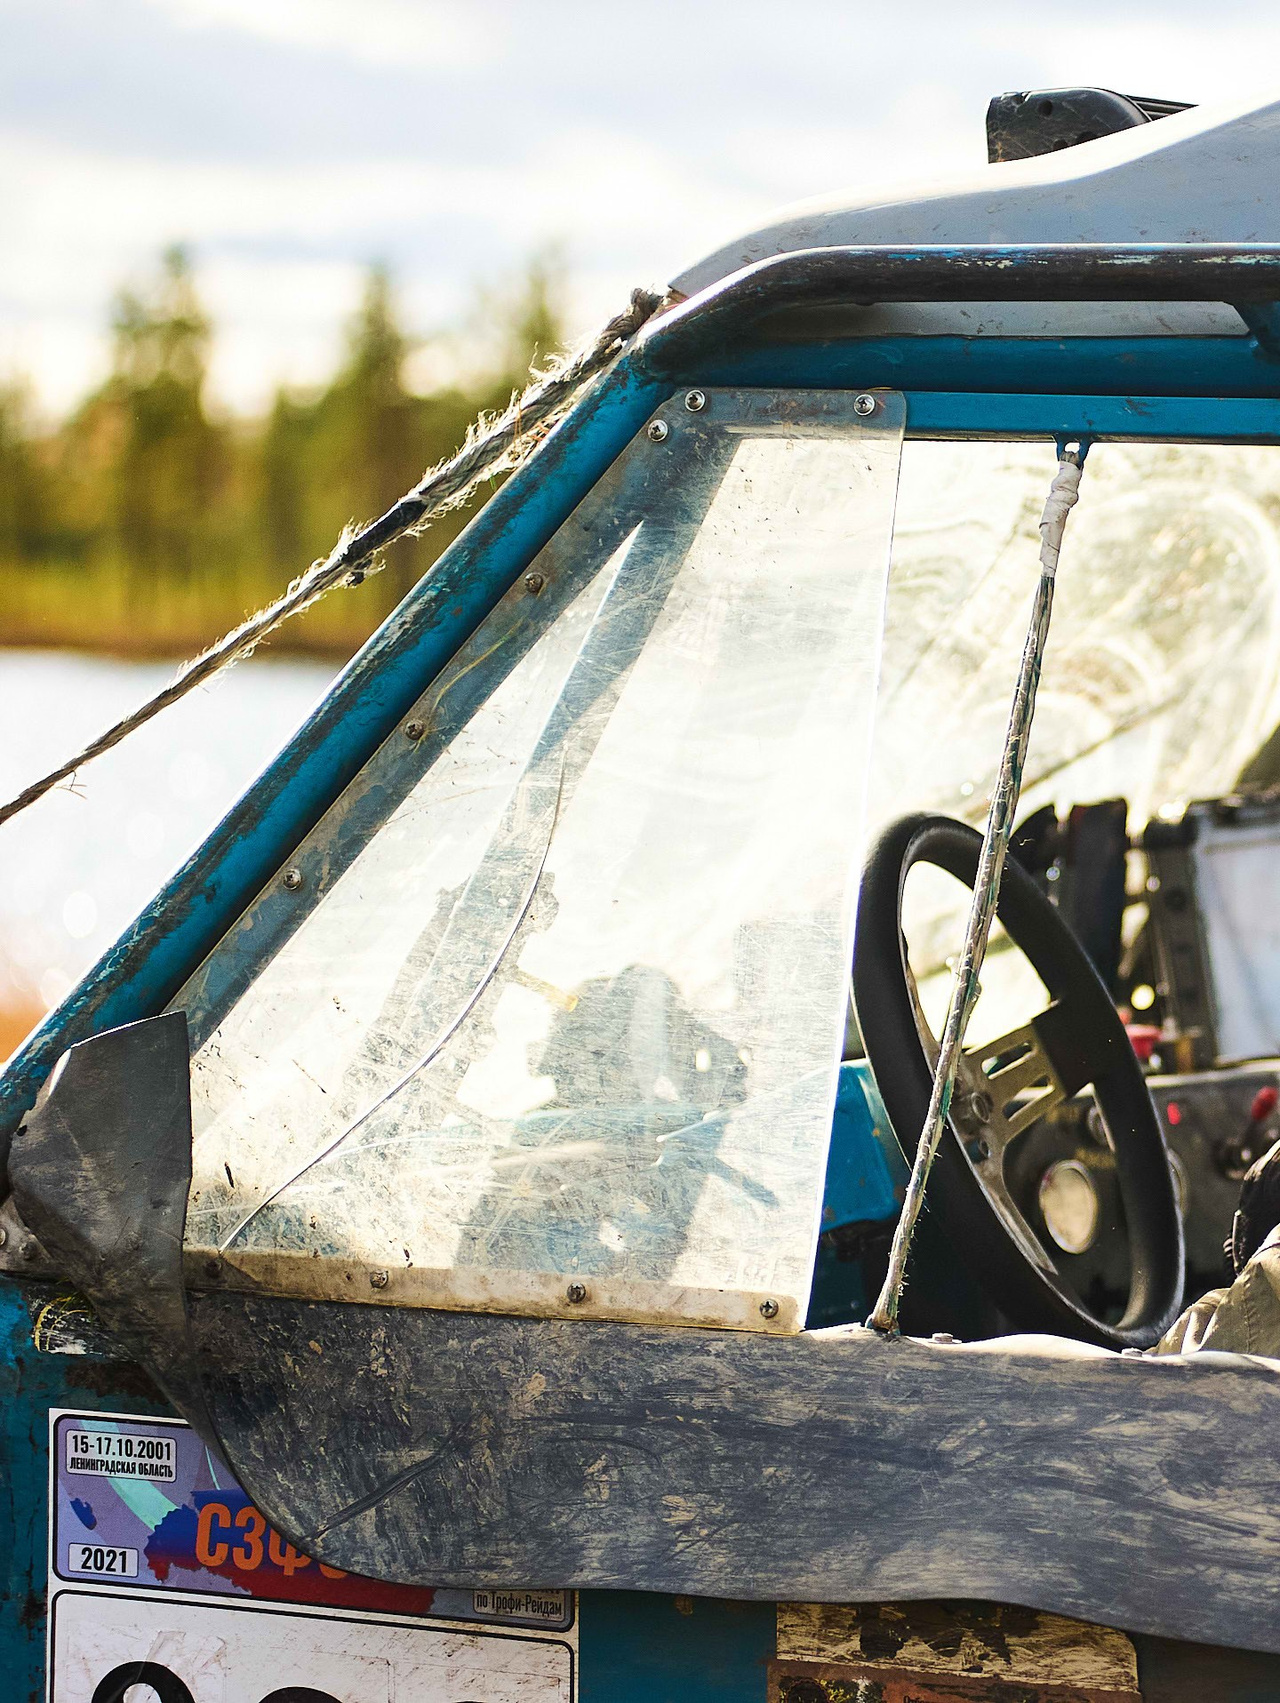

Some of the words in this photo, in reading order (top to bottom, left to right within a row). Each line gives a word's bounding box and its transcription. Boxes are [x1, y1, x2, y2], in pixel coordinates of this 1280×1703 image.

[72, 1434, 171, 1461] 15-17.10.2001
[69, 1456, 137, 1475] ЛЕНИНГРАДСКАЯ
[138, 1462, 173, 1478] ОБЛАСТЬ
[195, 1502, 348, 1579] СЗ
[81, 1546, 128, 1573] 2021
[476, 1594, 488, 1608] по
[490, 1591, 562, 1616] Трофи-Рейдам
